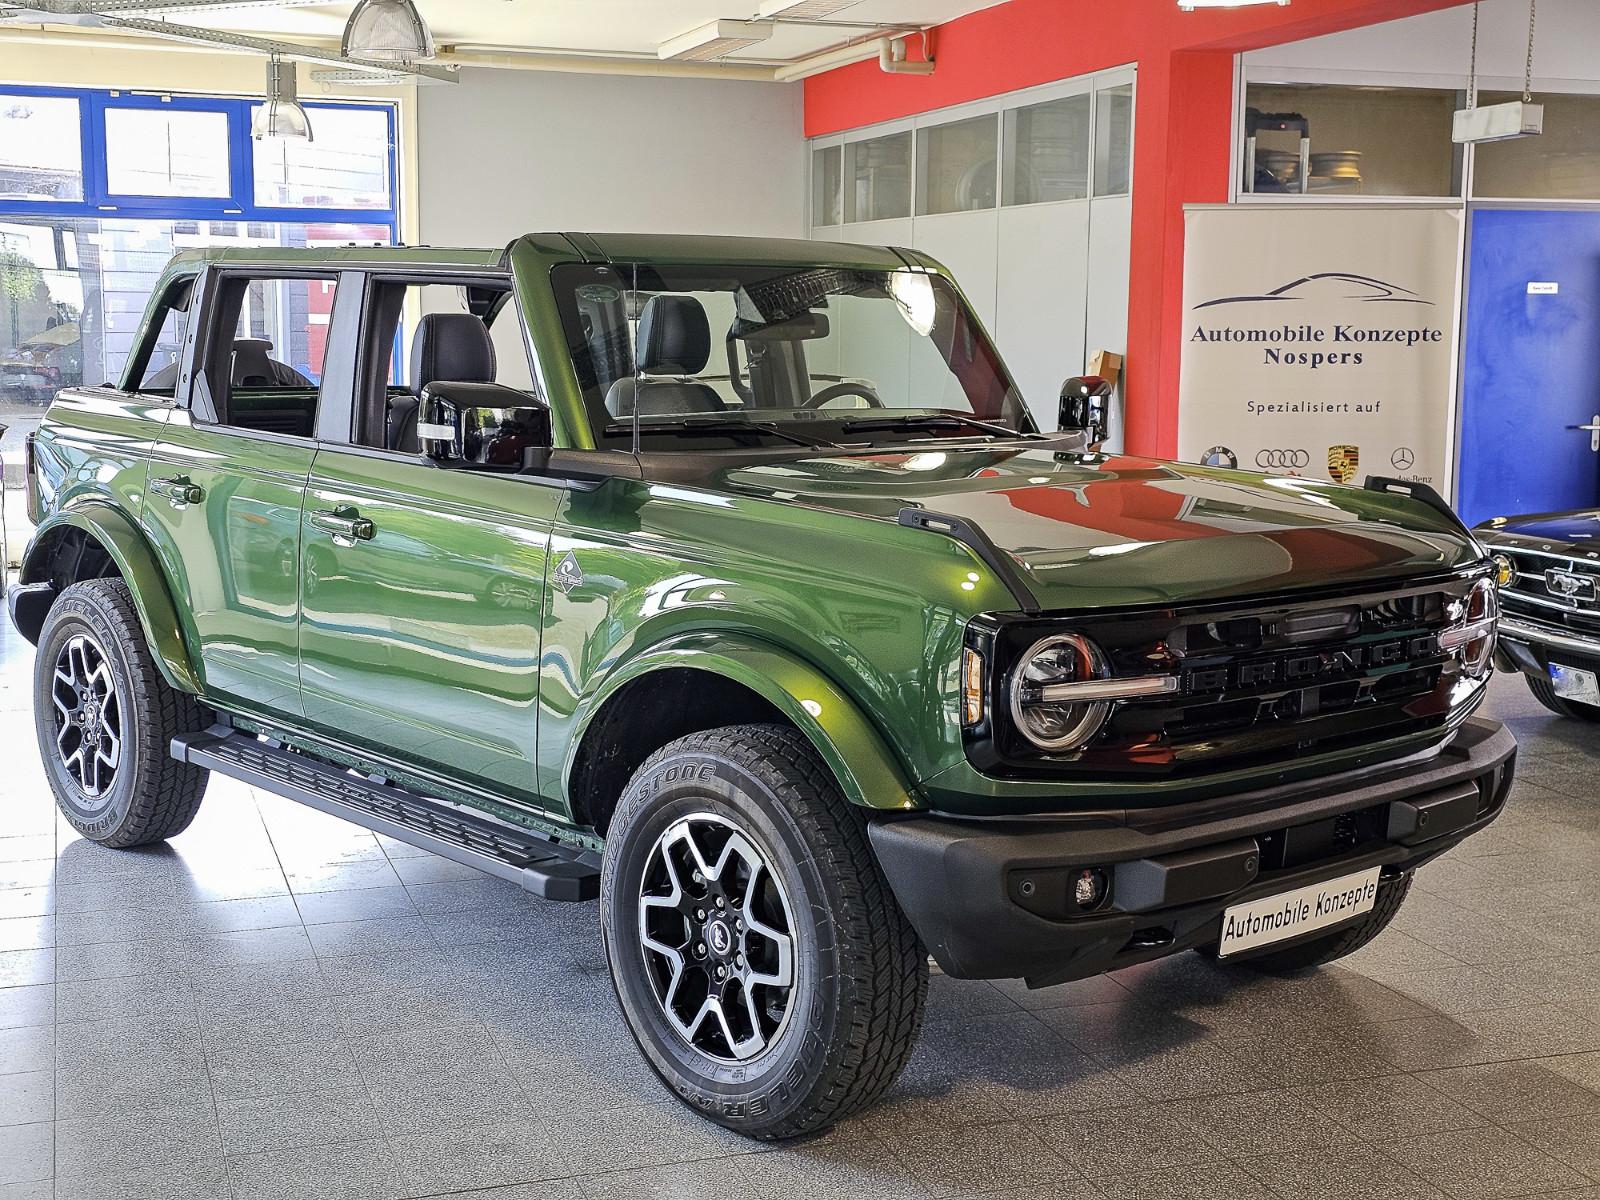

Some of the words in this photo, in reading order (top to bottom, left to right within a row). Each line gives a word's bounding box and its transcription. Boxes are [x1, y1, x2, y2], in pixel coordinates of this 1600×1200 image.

[1190, 325, 1325, 342] Automobile
[1333, 325, 1442, 347] Konzepte
[1264, 348, 1363, 369] Nospers
[1247, 400, 1349, 416] Spezialisiert
[1355, 401, 1381, 413] auf
[1224, 901, 1310, 942] Automobile
[1314, 878, 1375, 917] Konzepte
